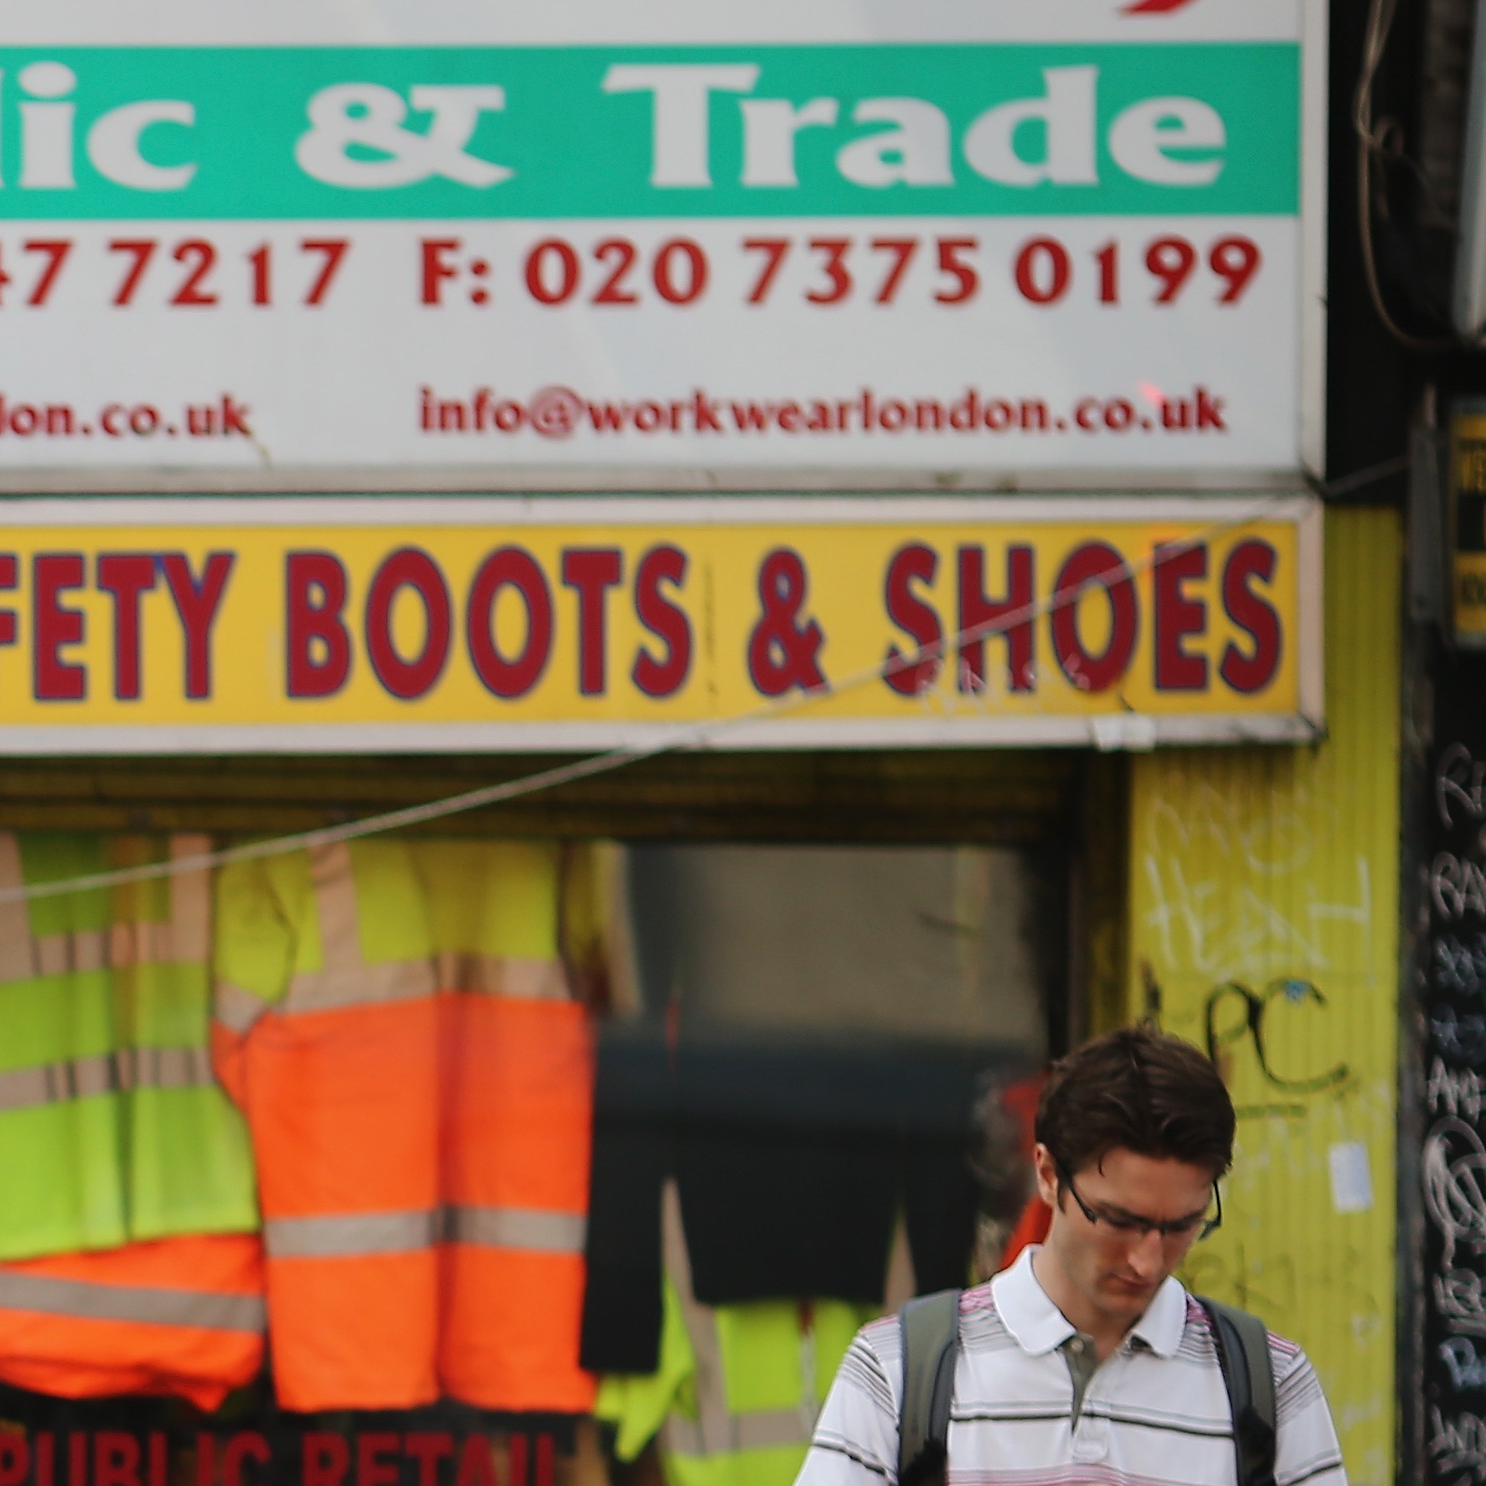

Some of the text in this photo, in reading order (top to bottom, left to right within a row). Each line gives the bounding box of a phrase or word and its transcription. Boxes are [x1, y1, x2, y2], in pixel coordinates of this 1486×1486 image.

[293, 82, 516, 190] &
[601, 63, 1227, 188] Trade
[108, 237, 351, 308] 7217
[419, 237, 491, 307] F:
[522, 237, 710, 308] 020
[742, 237, 981, 307] 7375
[1013, 235, 1263, 306] 0199
[419, 386, 1227, 437] info@workwearlondon.co.uk
[283, 543, 695, 703] BOOTS
[745, 545, 827, 701] &
[879, 538, 1285, 698] SHOES
